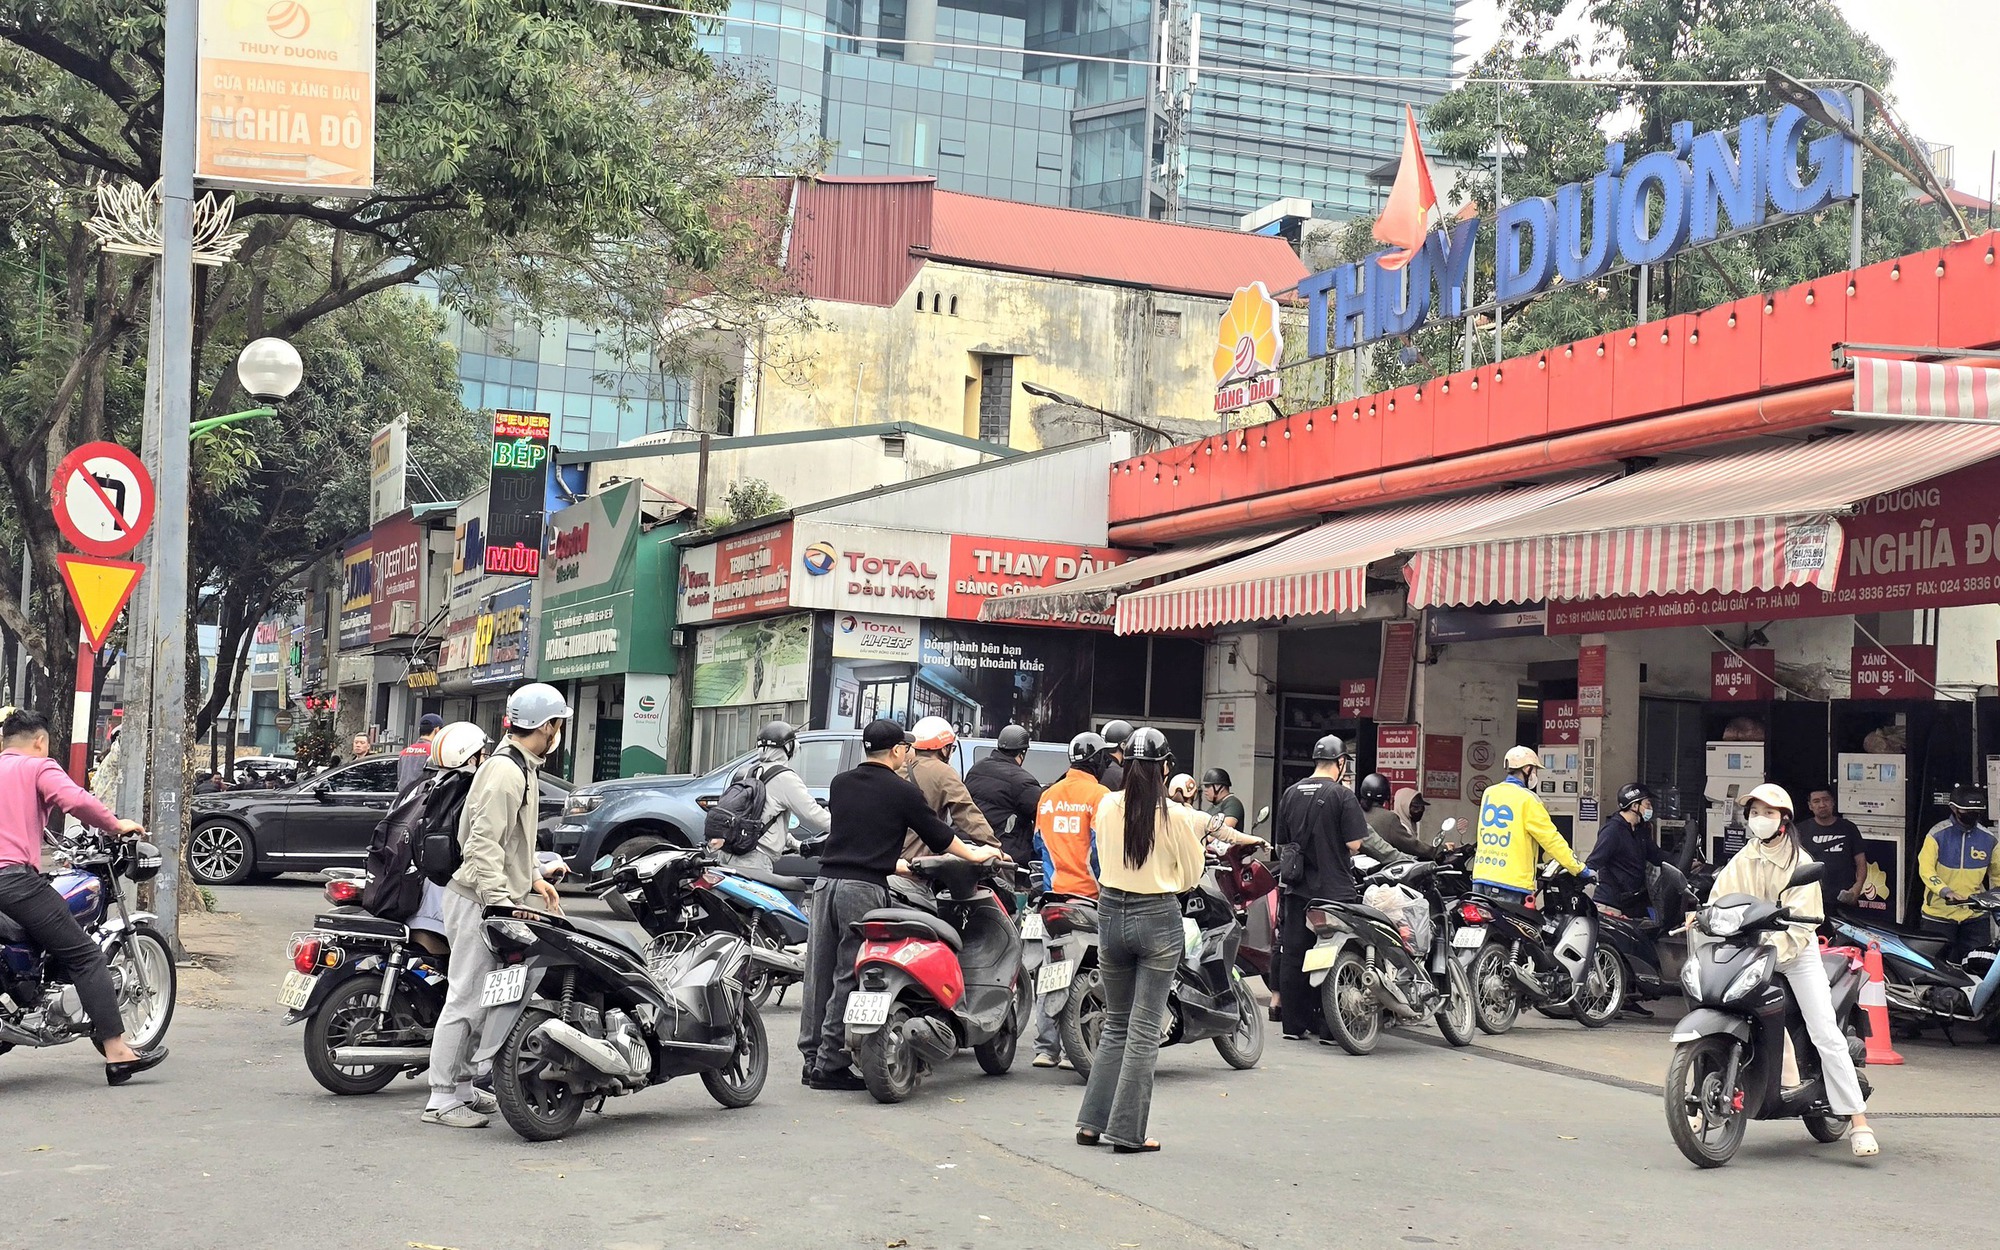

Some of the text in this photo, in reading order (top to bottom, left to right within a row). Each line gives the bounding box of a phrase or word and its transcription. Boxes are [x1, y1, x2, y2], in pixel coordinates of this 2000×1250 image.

[239, 41, 338, 61] THUY DUONG
[213, 72, 360, 101] CỬA HÀNG XĂNG DẦU
[210, 104, 362, 150] NGHĨA ĐÔ
[1496, 88, 1856, 301] DƯƠNG
[1214, 377, 1274, 411] XĂNG DẦU
[494, 437, 546, 469] BẾP
[501, 473, 535, 501] TỪ
[1876, 487, 1940, 514] DƯƠNG
[489, 510, 541, 537] HÚT
[1850, 518, 1956, 577] NGHĨA
[485, 542, 540, 575] MÙI
[843, 551, 938, 579] TOTAL
[973, 549, 1050, 580] THAY
[848, 578, 935, 601] Dầu Nhớt
[1821, 592, 1837, 604] ĐT:
[1838, 589, 1856, 602] 024
[1859, 586, 1884, 601] 3836
[1886, 584, 1911, 598] 2557
[1916, 582, 1938, 596] FAX:
[1940, 579, 1961, 593] 024
[1964, 576, 1991, 591] 3836
[1556, 593, 1800, 625] ĐC: 181 HOÀNG QUỐC VIỆT P. NGHĨA ĐÔ Q. CẦU GIẤY TP. HÀ NỘI
[861, 621, 906, 634] TOTAL
[861, 634, 913, 649] HI-PERF
[924, 638, 1022, 657] Đồng hành bên bạn
[923, 654, 1045, 672] trong từng khoảnh khắc
[1724, 656, 1743, 669] XĂNG
[1862, 653, 1887, 666] XĂNG
[1715, 672, 1751, 686] RON 95-III
[1858, 669, 1915, 684] RON 95 III
[1350, 682, 1365, 694] XĂNG
[1343, 697, 1355, 707] RON
[1558, 703, 1573, 717] DẦU
[634, 712, 659, 720] Castrol
[1545, 719, 1580, 730] DO 0,05S
[1481, 794, 1514, 829] be
[1970, 846, 1987, 861] be
[1043, 963, 1067, 979] 20-F1
[1040, 975, 1068, 992] 748.11
[483, 985, 520, 1005] 712.10
[854, 995, 884, 1007] 29-P1
[847, 1010, 885, 1023] 845.70
